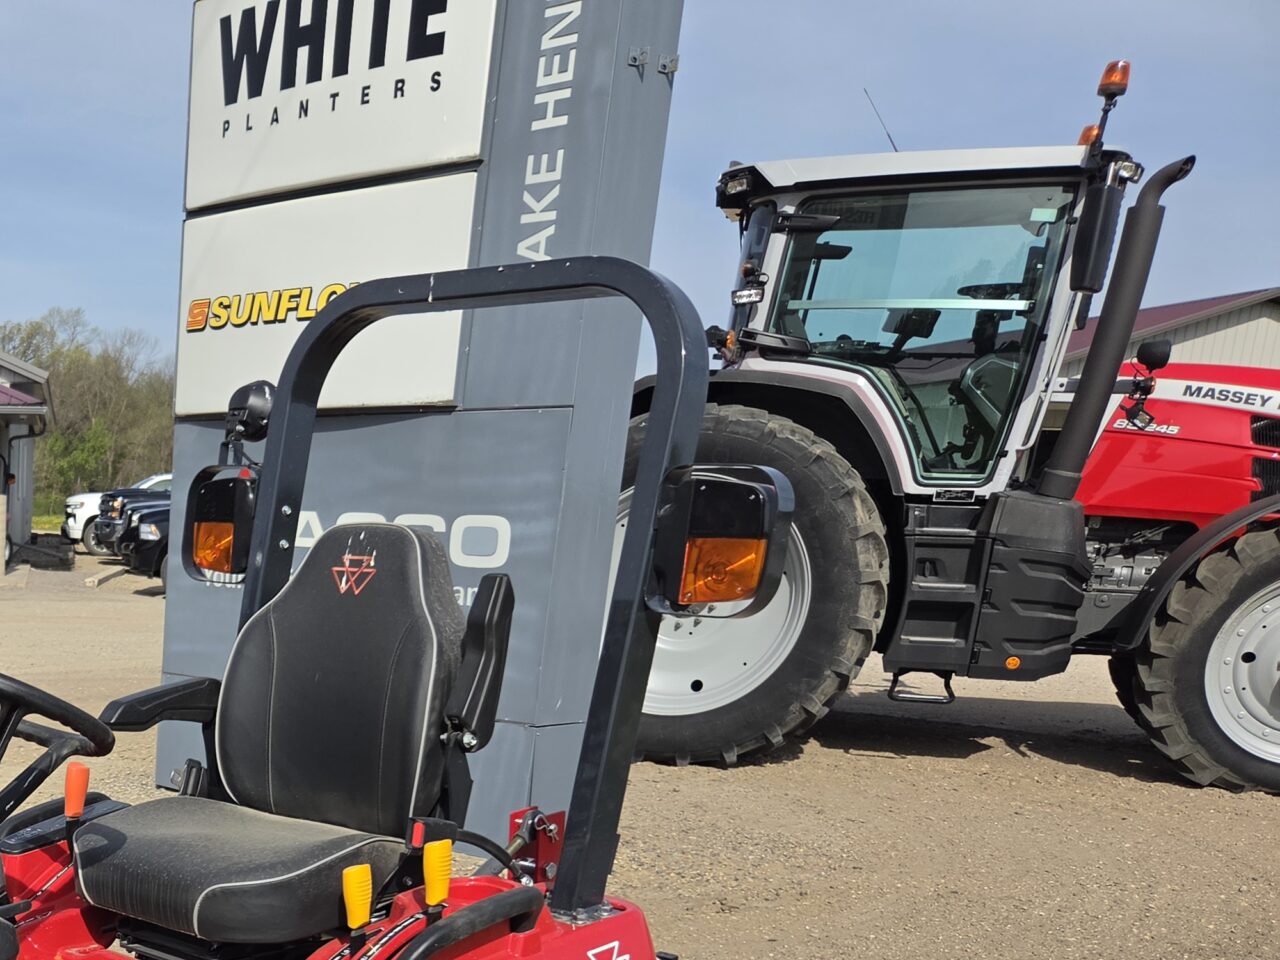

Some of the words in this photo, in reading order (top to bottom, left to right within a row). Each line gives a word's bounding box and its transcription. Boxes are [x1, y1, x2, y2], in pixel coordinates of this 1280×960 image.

[531, 0, 583, 132] HEN
[222, 71, 442, 139] PLANTERS
[516, 149, 565, 263] AKE
[209, 282, 360, 329] SUNFLO
[1182, 384, 1273, 408] MASSEY
